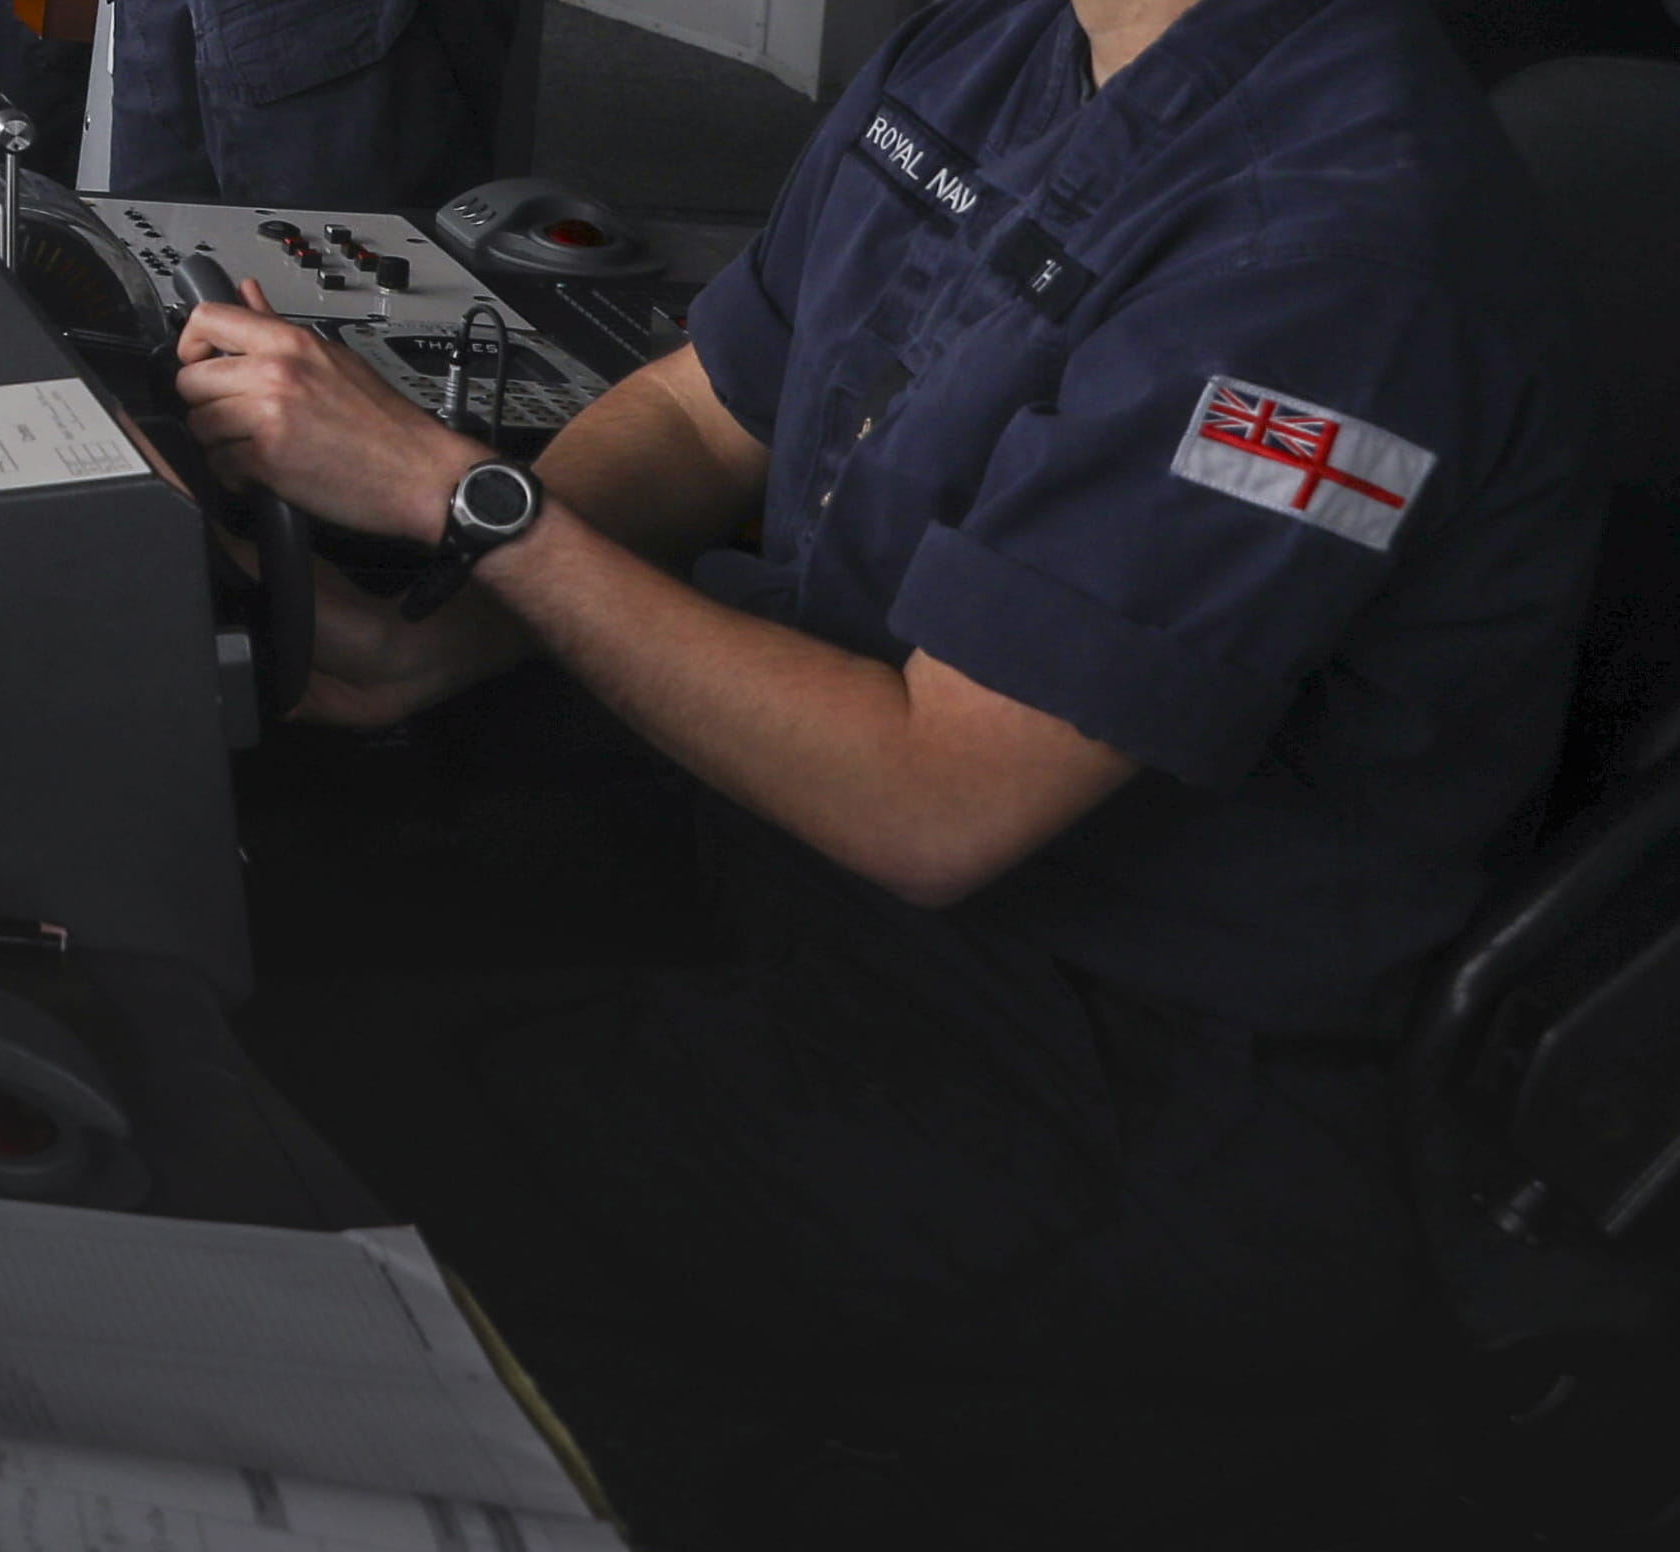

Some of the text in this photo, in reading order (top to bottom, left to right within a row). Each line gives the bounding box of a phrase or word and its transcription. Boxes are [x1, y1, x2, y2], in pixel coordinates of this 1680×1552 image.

[865, 115, 978, 214] ROYAL NAV
[414, 338, 500, 354] THAES
